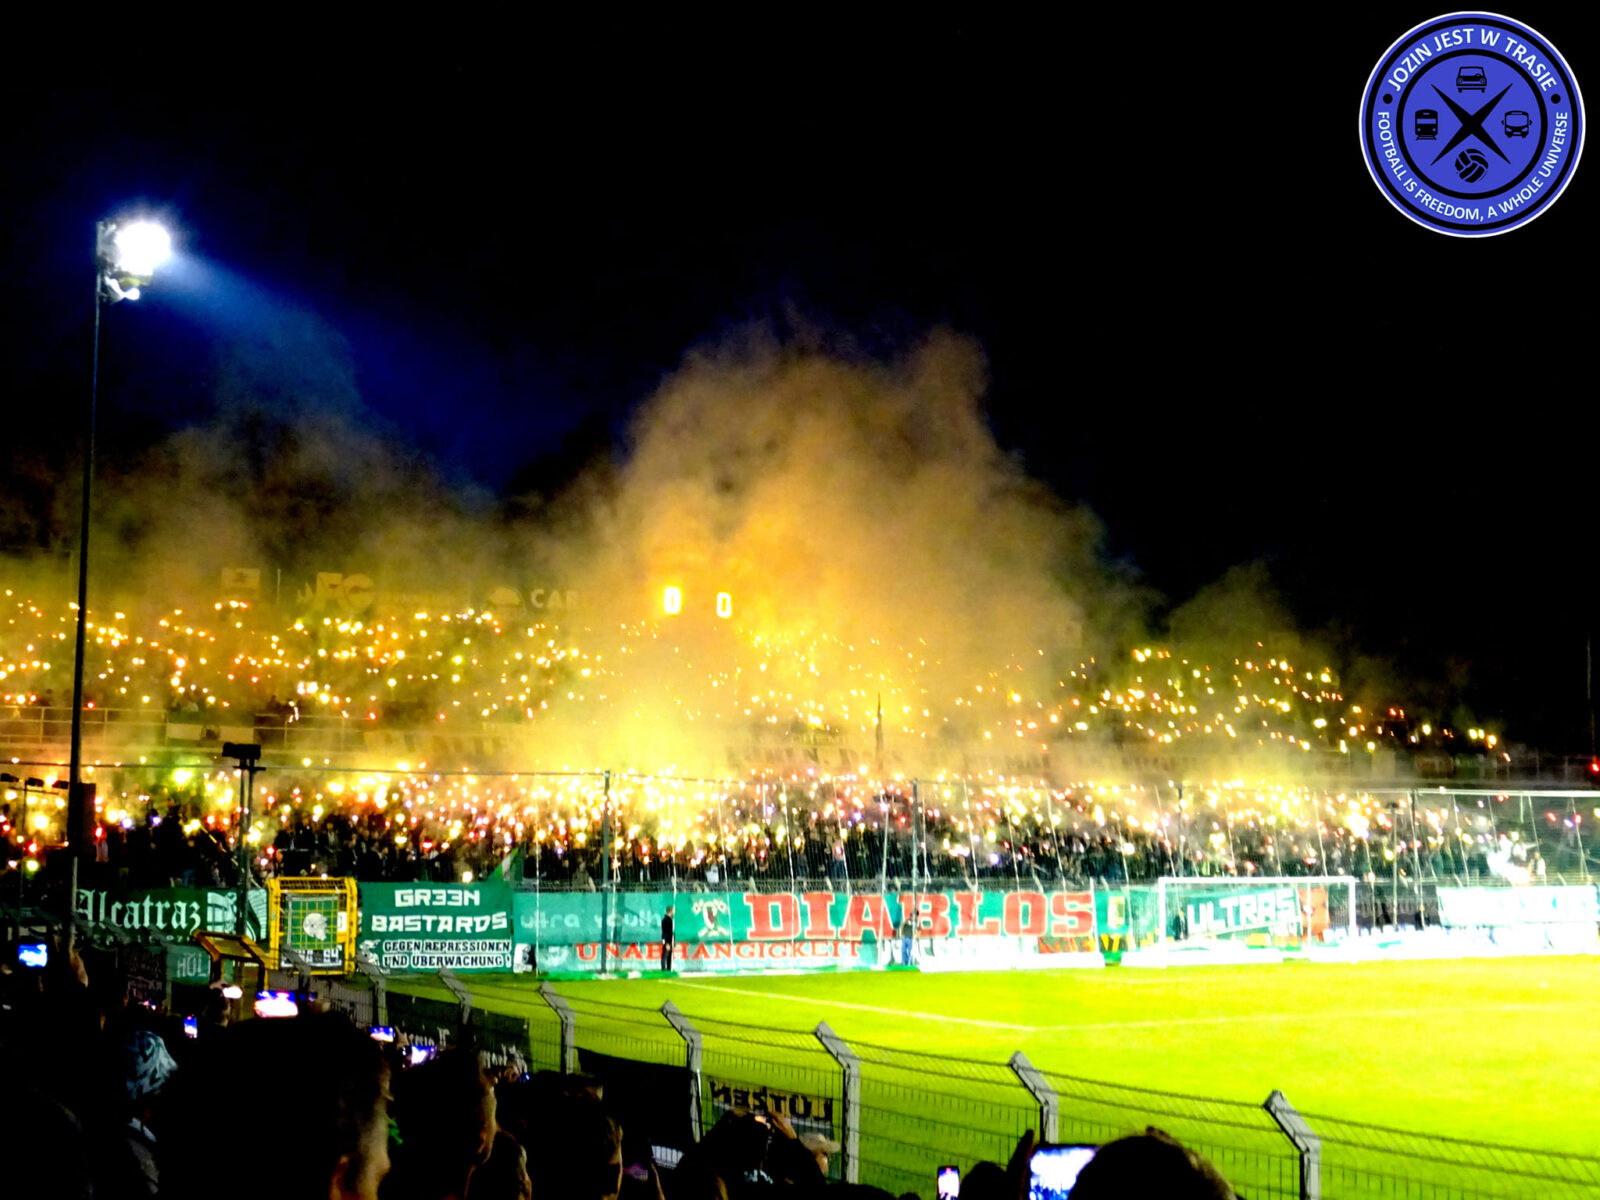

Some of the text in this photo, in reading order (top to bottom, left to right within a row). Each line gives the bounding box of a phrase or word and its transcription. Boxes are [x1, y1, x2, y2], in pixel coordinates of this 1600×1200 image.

[664, 587, 732, 618] 0 0
[76, 888, 201, 934] Alcatraz
[371, 912, 508, 933] BASTARDS
[744, 891, 1095, 940] DIABLOS
[1187, 888, 1296, 934] ULTRAS
[383, 940, 511, 954] GEGEN REPRESSIONEN
[383, 954, 408, 969] UND
